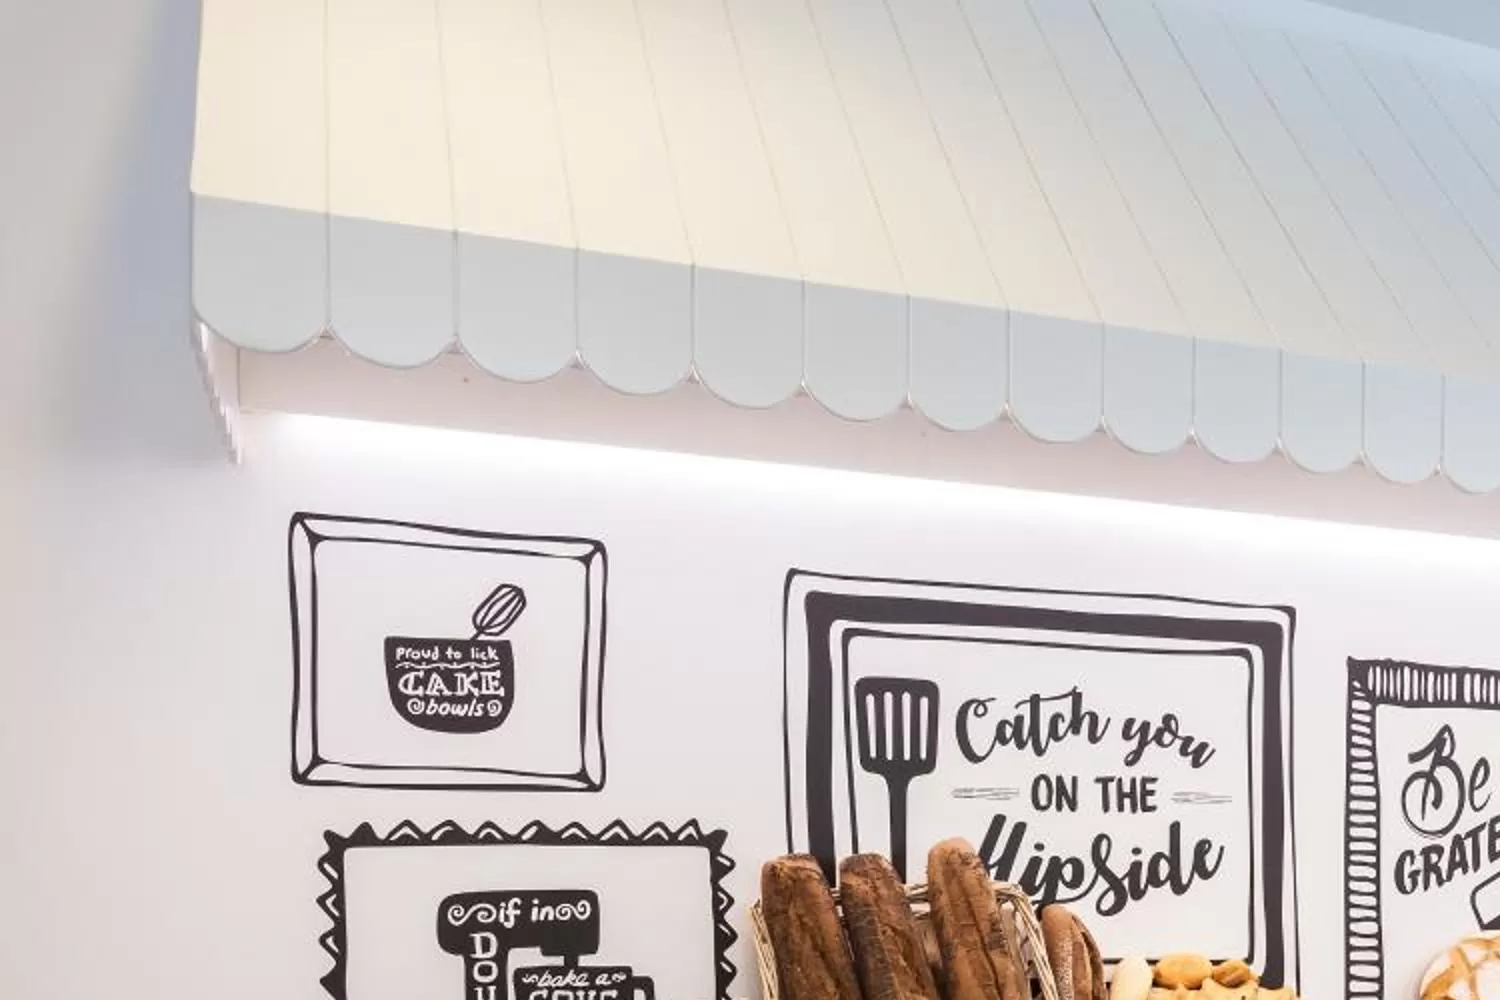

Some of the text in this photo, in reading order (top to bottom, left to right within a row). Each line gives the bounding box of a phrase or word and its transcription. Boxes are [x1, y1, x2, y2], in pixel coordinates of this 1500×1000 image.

[445, 646, 462, 659] to
[470, 645, 499, 661] lick
[397, 670, 505, 697] CAKE
[425, 698, 485, 717] bowls
[955, 686, 1216, 769] Catch you
[1031, 773, 1158, 814] ON THE
[1401, 724, 1492, 837] Be
[499, 897, 555, 929] if in
[537, 969, 590, 988] bake
